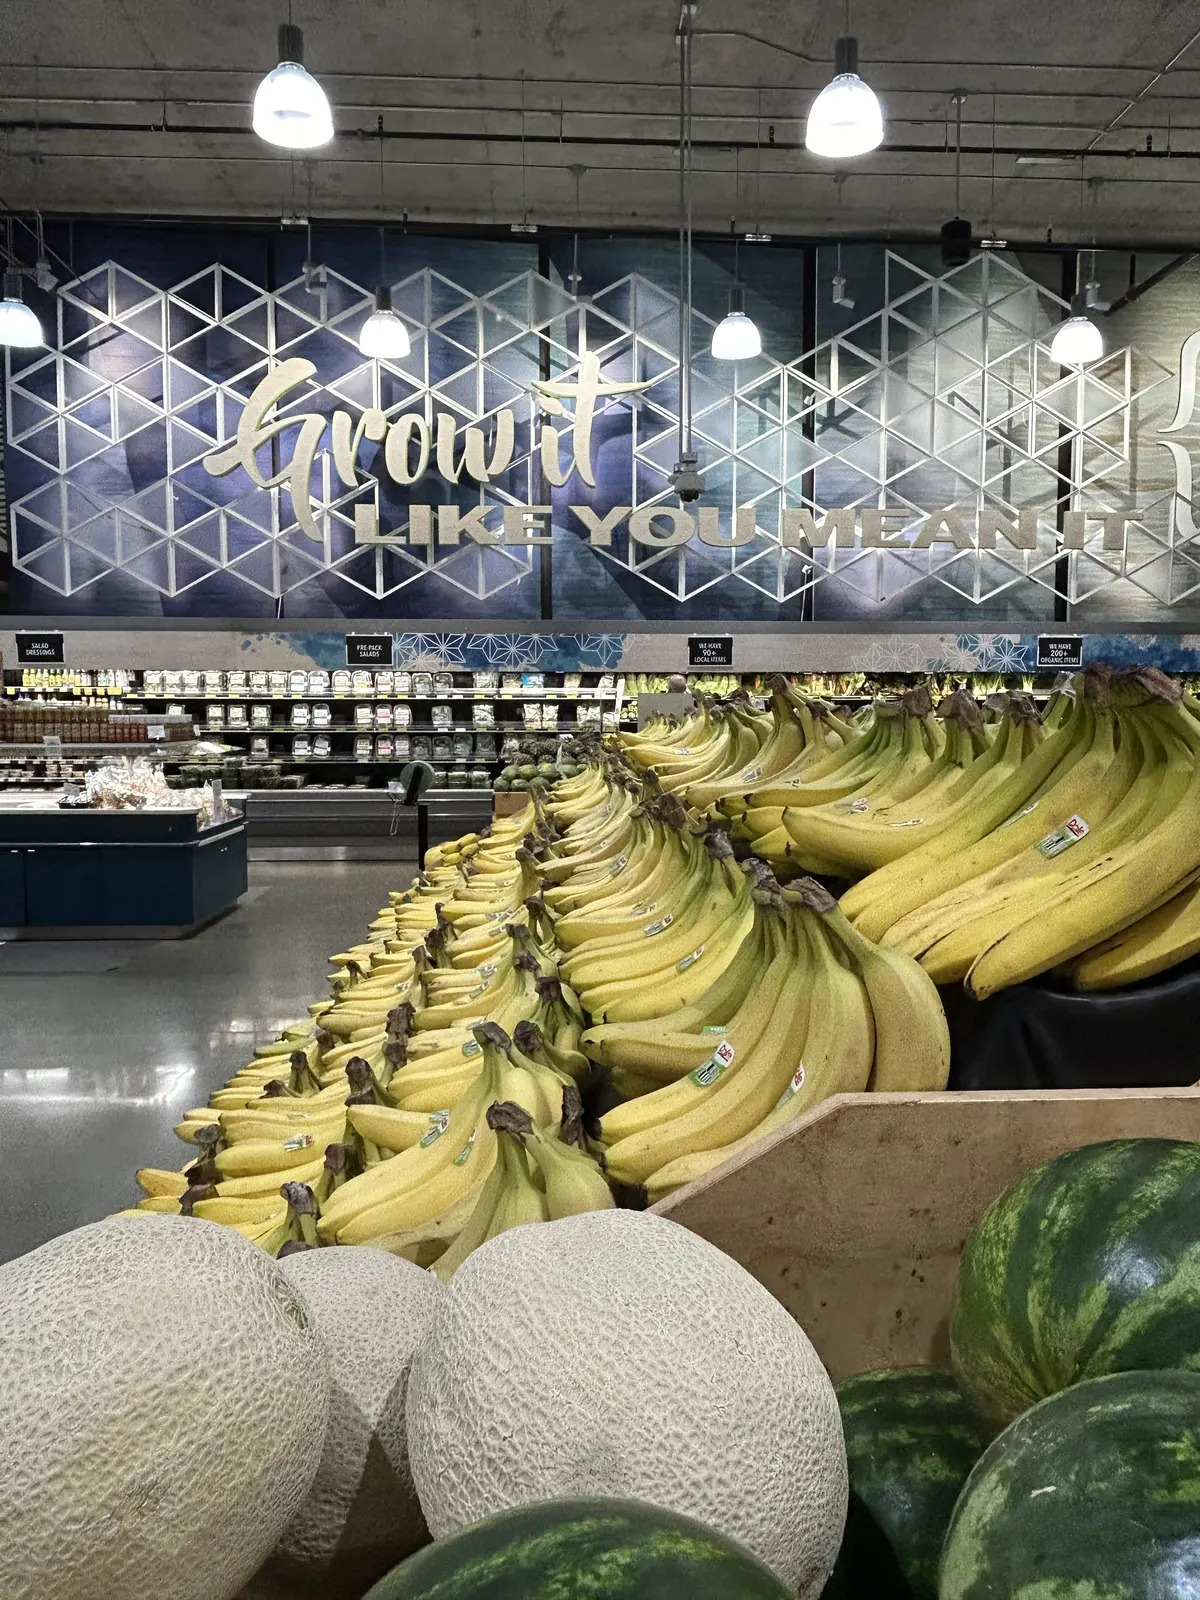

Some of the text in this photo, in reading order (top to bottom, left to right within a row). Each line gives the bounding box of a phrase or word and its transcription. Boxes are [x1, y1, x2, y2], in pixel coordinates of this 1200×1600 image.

[203, 351, 652, 542] Grow it
[354, 503, 1144, 551] LIKE YOU MEAN IT
[359, 650, 380, 658] SALADS
[702, 649, 717, 657] 90+
[1050, 649, 1068, 657] 200+
[1040, 656, 1079, 664] ORGANIC ITEMS
